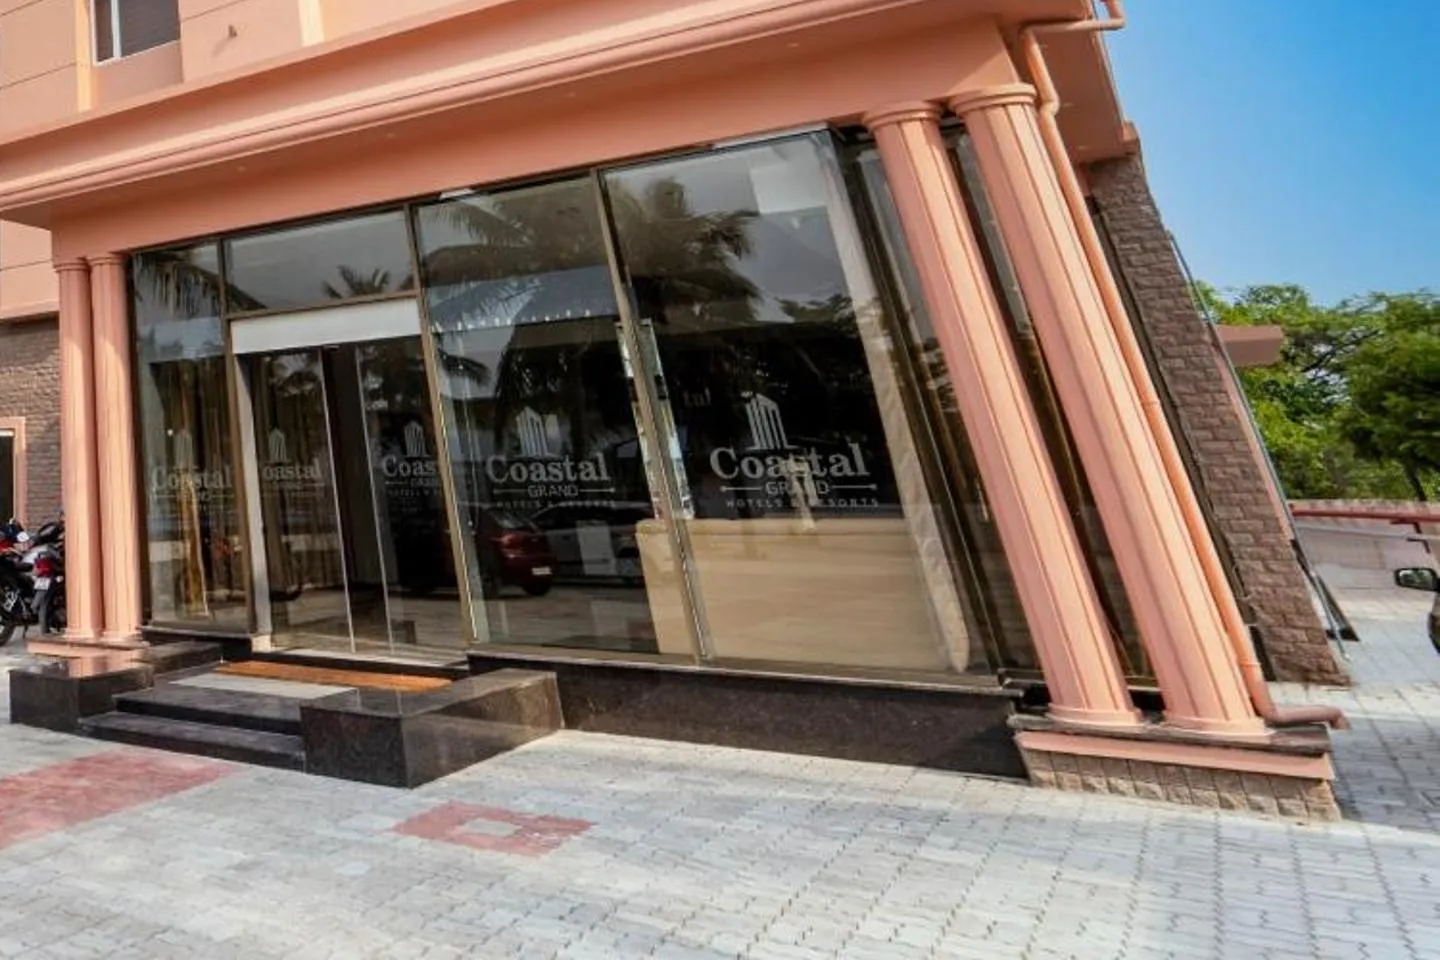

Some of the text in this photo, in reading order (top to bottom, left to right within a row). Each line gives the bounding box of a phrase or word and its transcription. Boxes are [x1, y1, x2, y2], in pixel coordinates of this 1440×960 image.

[486, 451, 611, 483] Coastal
[709, 442, 871, 480] Coastal
[527, 484, 580, 498] GRAND
[764, 480, 831, 496] GRD
